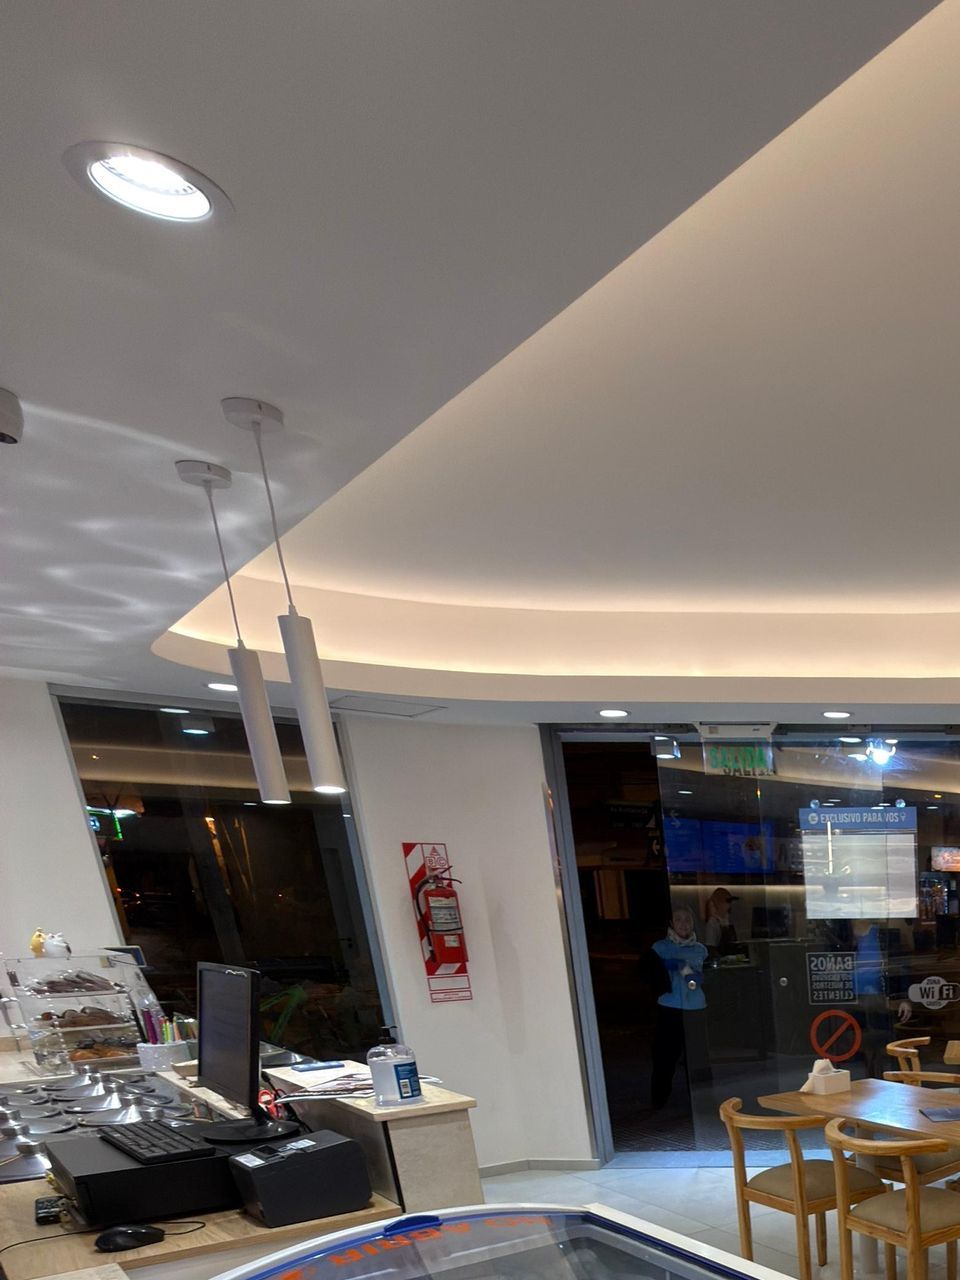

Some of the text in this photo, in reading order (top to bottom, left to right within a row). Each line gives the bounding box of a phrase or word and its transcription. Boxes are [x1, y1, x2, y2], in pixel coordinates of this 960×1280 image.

[710, 746, 767, 768] SALIDA
[820, 813, 860, 823] EXCLUSIVO
[862, 812, 882, 822] PARA
